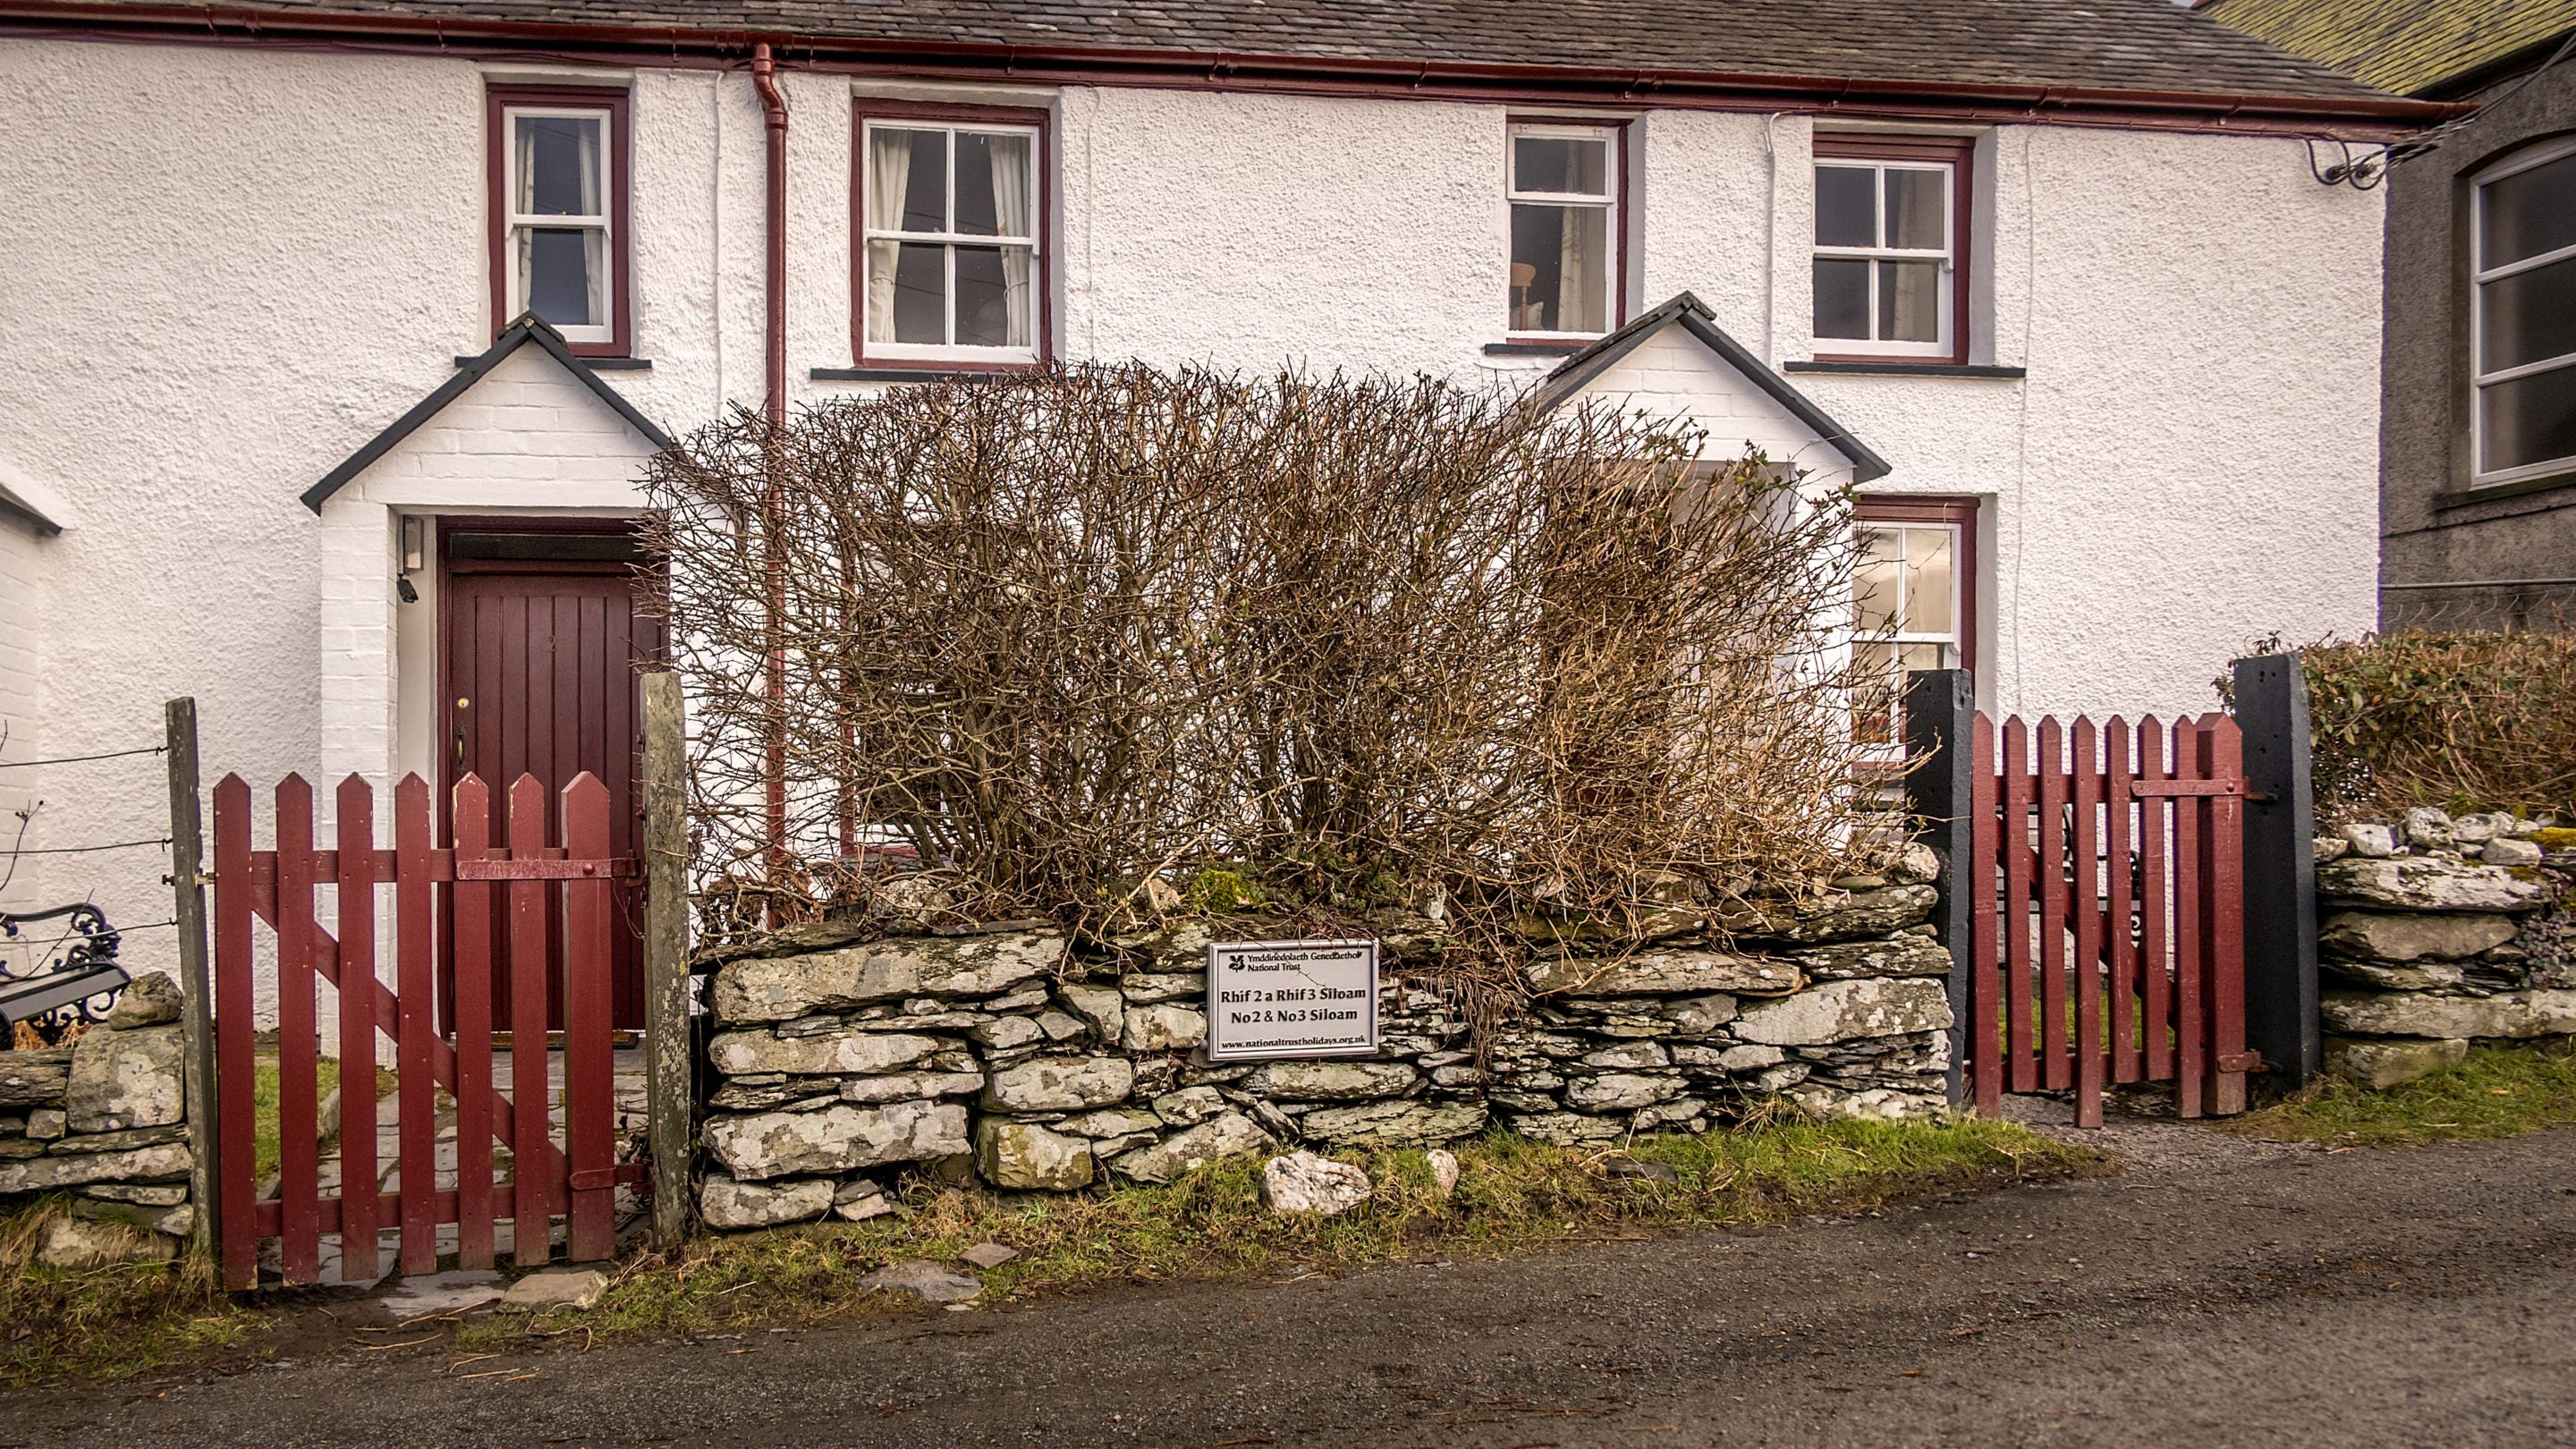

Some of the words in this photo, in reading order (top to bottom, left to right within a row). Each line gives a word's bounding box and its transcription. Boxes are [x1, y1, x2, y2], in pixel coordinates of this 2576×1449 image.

[1248, 963, 1280, 971] National
[1221, 989, 1251, 1003] Rhif
[1253, 990, 1262, 1002] 2
[1265, 992, 1273, 1002] a
[1276, 988, 1307, 1002] Rhif
[1308, 988, 1317, 1000] 3
[1319, 987, 1366, 1000] Siloam
[1264, 1010, 1274, 1022] &
[1309, 1008, 1358, 1021] Siloam
[1222, 1035, 1366, 1048] www.nationaltrustholidays.org.uk
